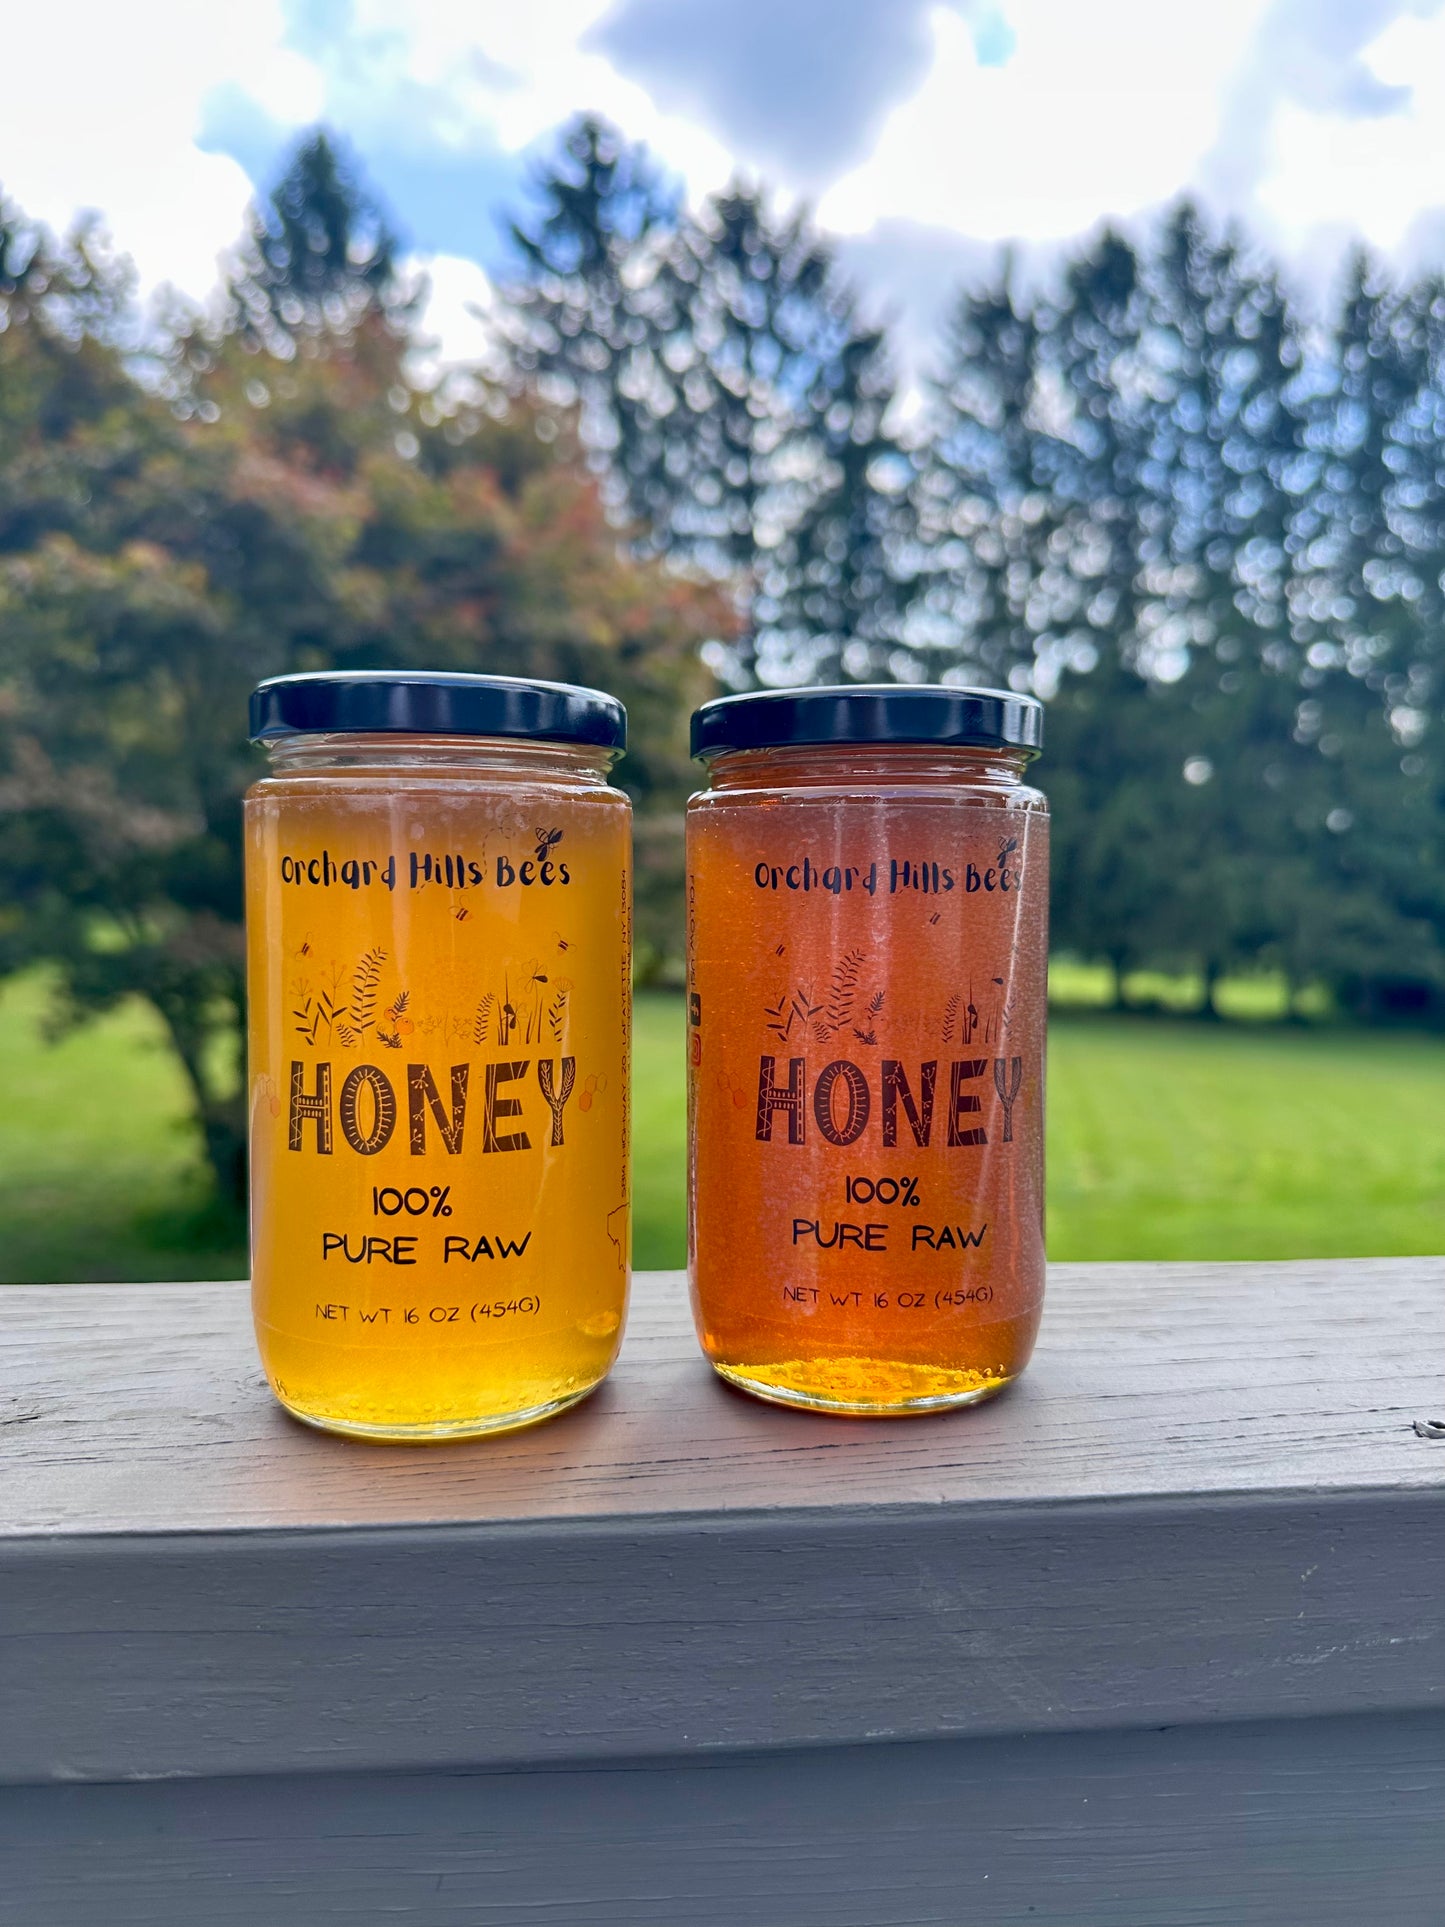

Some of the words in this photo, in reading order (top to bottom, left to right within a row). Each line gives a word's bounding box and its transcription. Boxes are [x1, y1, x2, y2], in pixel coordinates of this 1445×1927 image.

[282, 851, 396, 891] Orchard
[409, 852, 483, 888] Hills
[496, 856, 571, 887] Bees
[755, 857, 877, 896] Orchard
[890, 859, 955, 894] Hills
[965, 863, 1022, 893] Bees
[288, 1056, 576, 1156] HONEY
[755, 1055, 1022, 1147] HONEY
[373, 1185, 453, 1218] 100%
[846, 1175, 921, 1207] 100%
[322, 1232, 419, 1265] PURE
[443, 1231, 532, 1264] RAW
[791, 1218, 889, 1252] PURE
[912, 1223, 988, 1251] RAW
[315, 1303, 349, 1321] NET
[360, 1308, 391, 1324] WT
[403, 1307, 420, 1324] 16
[429, 1306, 461, 1322] OZ
[470, 1295, 541, 1323] (454G)
[783, 1286, 819, 1304] NET
[830, 1291, 863, 1308] WT
[873, 1291, 889, 1309] 16
[897, 1291, 926, 1308] OZ
[934, 1286, 993, 1309] (454G)
